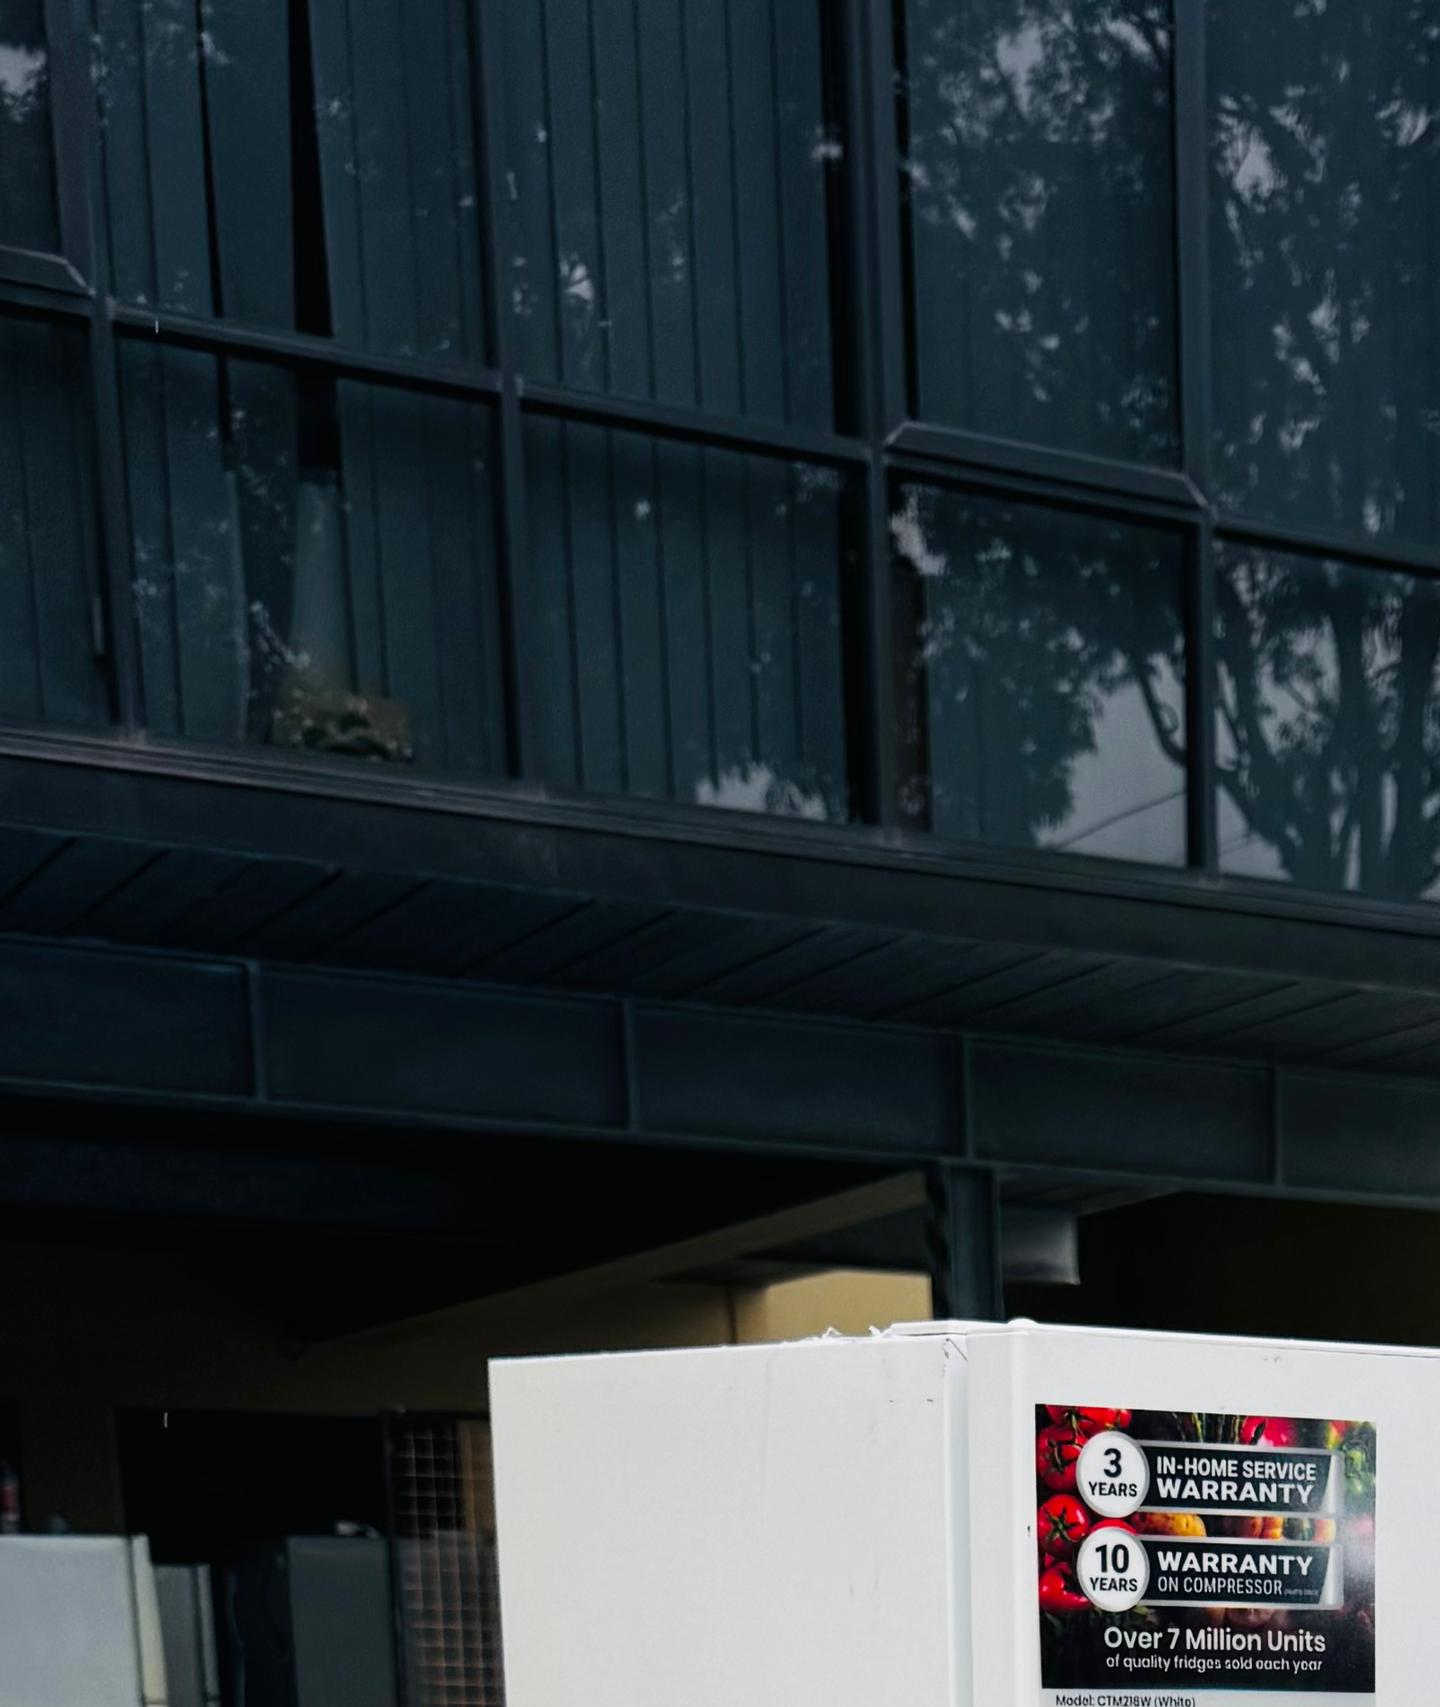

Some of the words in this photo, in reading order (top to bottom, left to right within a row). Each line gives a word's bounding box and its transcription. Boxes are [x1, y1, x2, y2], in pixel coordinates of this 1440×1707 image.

[1104, 1448, 1122, 1478] 3
[1156, 1456, 1238, 1478] IN-HOME
[1242, 1460, 1317, 1481] SERVICE
[1088, 1482, 1138, 1498] YEARS
[1156, 1479, 1314, 1504] WARRANTY
[1095, 1544, 1130, 1574] 10
[1157, 1551, 1314, 1576] WARRANTY
[1090, 1577, 1138, 1592] YEARS
[1158, 1576, 1179, 1593] ON
[1183, 1578, 1283, 1596] COMPRESSOR
[1104, 1626, 1162, 1650] Over
[1168, 1628, 1180, 1650] 7
[1185, 1628, 1262, 1651] Million
[1268, 1630, 1326, 1652] Units
[1106, 1654, 1120, 1668] of
[1123, 1656, 1171, 1672] quality
[1174, 1656, 1222, 1673] fridges
[1225, 1657, 1252, 1670] sold
[1256, 1657, 1289, 1671] each
[1292, 1659, 1322, 1674] year
